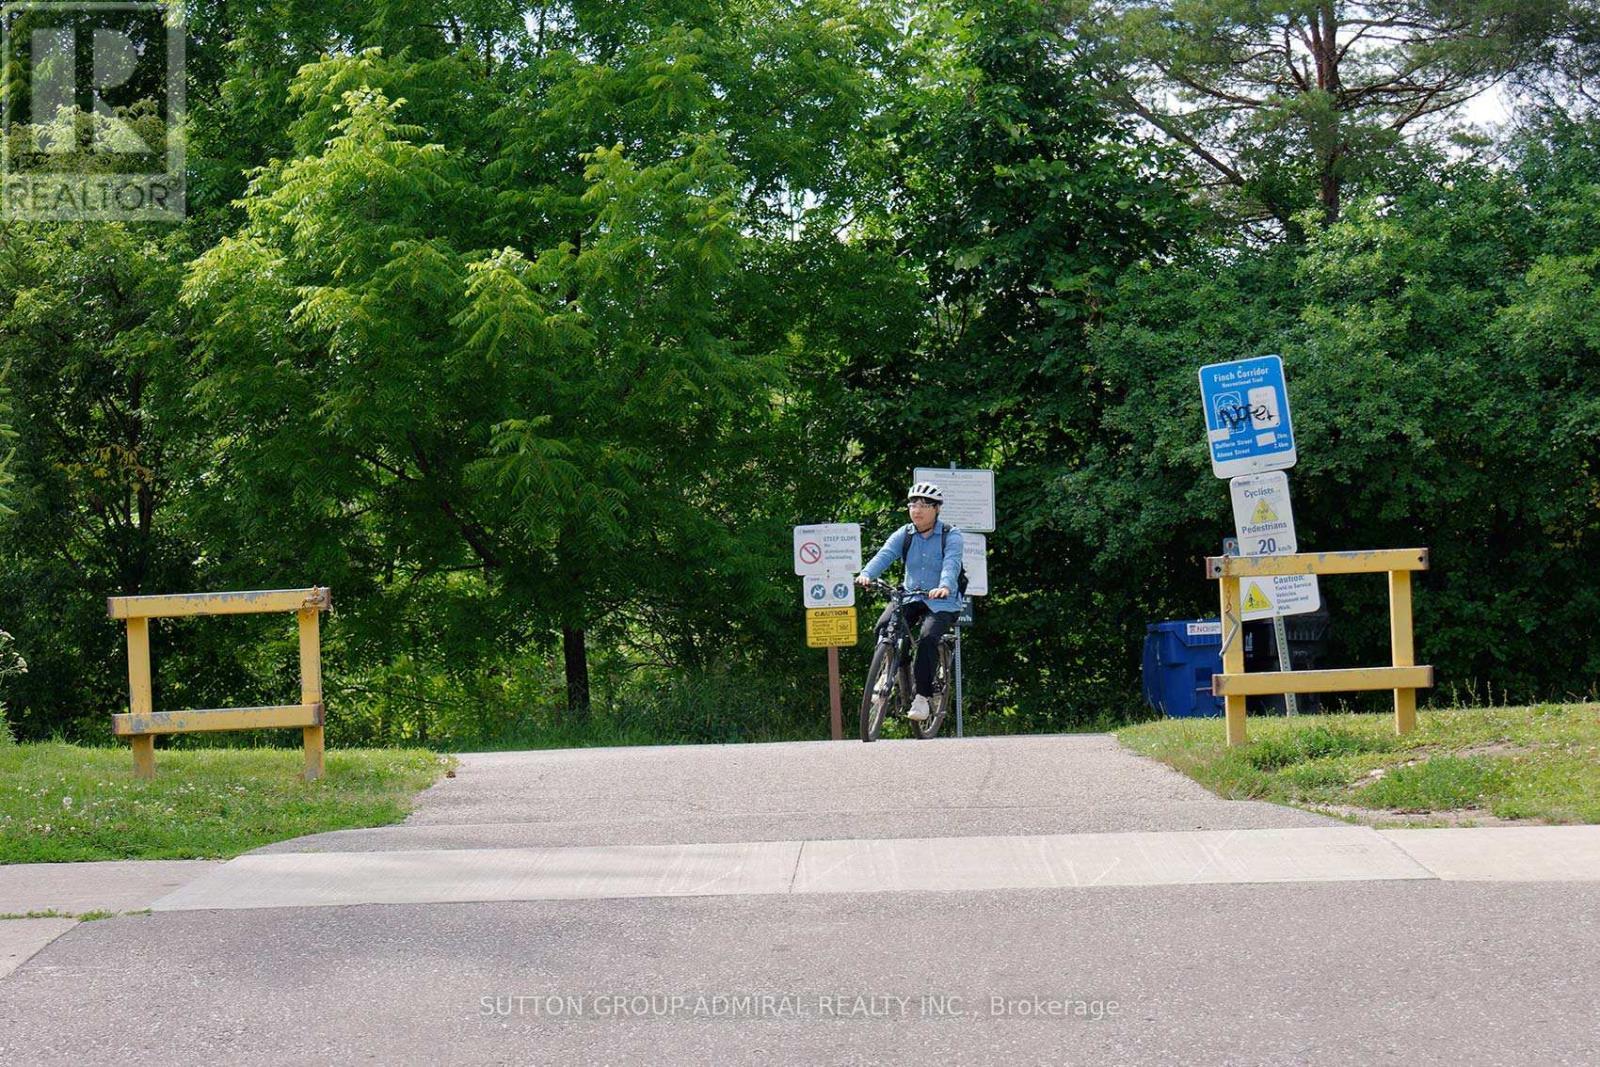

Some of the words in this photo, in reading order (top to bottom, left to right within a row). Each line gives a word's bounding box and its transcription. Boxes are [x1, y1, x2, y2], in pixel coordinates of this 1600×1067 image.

[1213, 371, 1235, 383] Finch
[1237, 367, 1269, 379] Corridor
[1235, 448, 1250, 456] Street
[1244, 487, 1274, 498] Cyclists
[1241, 522, 1287, 534] Pedestrians
[1258, 538, 1276, 554] 20
[814, 609, 848, 617] CAUTION
